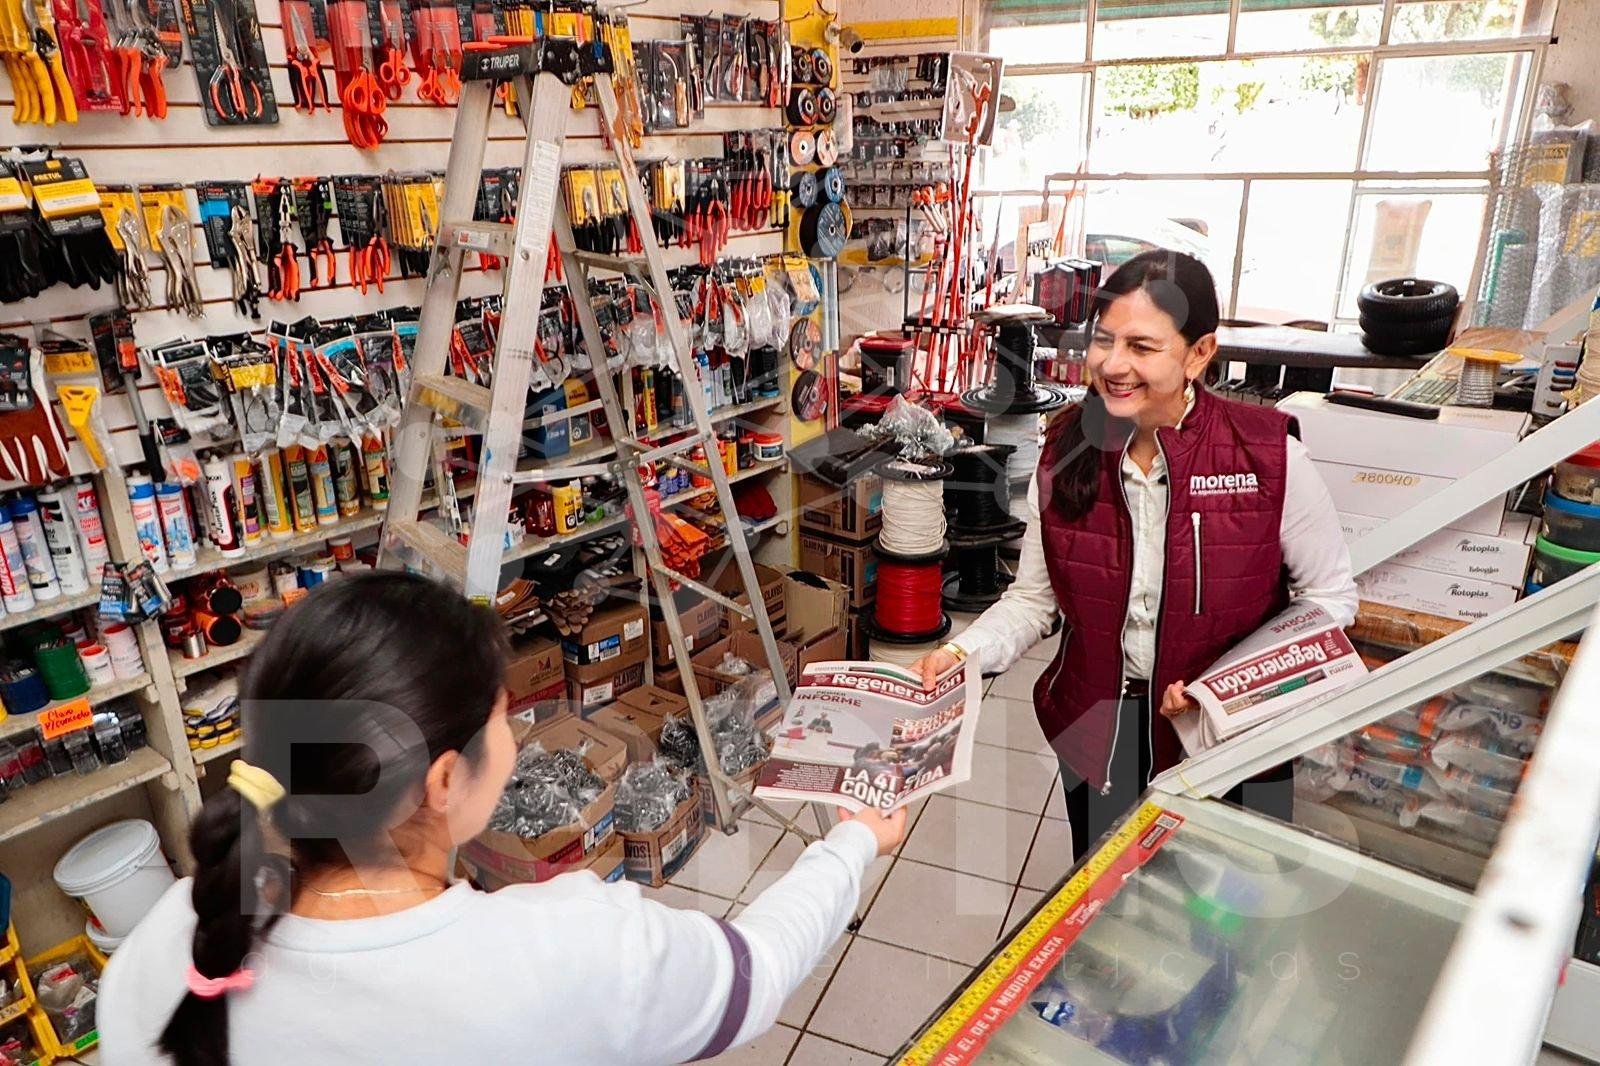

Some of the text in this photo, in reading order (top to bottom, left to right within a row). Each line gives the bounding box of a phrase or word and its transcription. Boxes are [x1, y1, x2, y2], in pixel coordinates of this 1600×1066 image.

[490, 54, 519, 69] TRUPER
[1190, 473, 1258, 489] morena
[1360, 472, 1413, 487] 780040
[1461, 544, 1500, 553] Rotoplas
[1451, 588, 1489, 598] Rotoplas
[1270, 608, 1325, 634] INFORME
[1210, 641, 1328, 695] Regeneración
[832, 673, 963, 704] Regeneración
[797, 694, 863, 707] INFORME
[843, 767, 870, 785] LA
[874, 773, 898, 792] 4T
[957, 1032, 977, 1053] EL
[970, 1015, 991, 1036] DE
[985, 1002, 1002, 1021] LA
[1000, 969, 1035, 1012] MEDIDA
[1029, 935, 1064, 971] EXACTA
